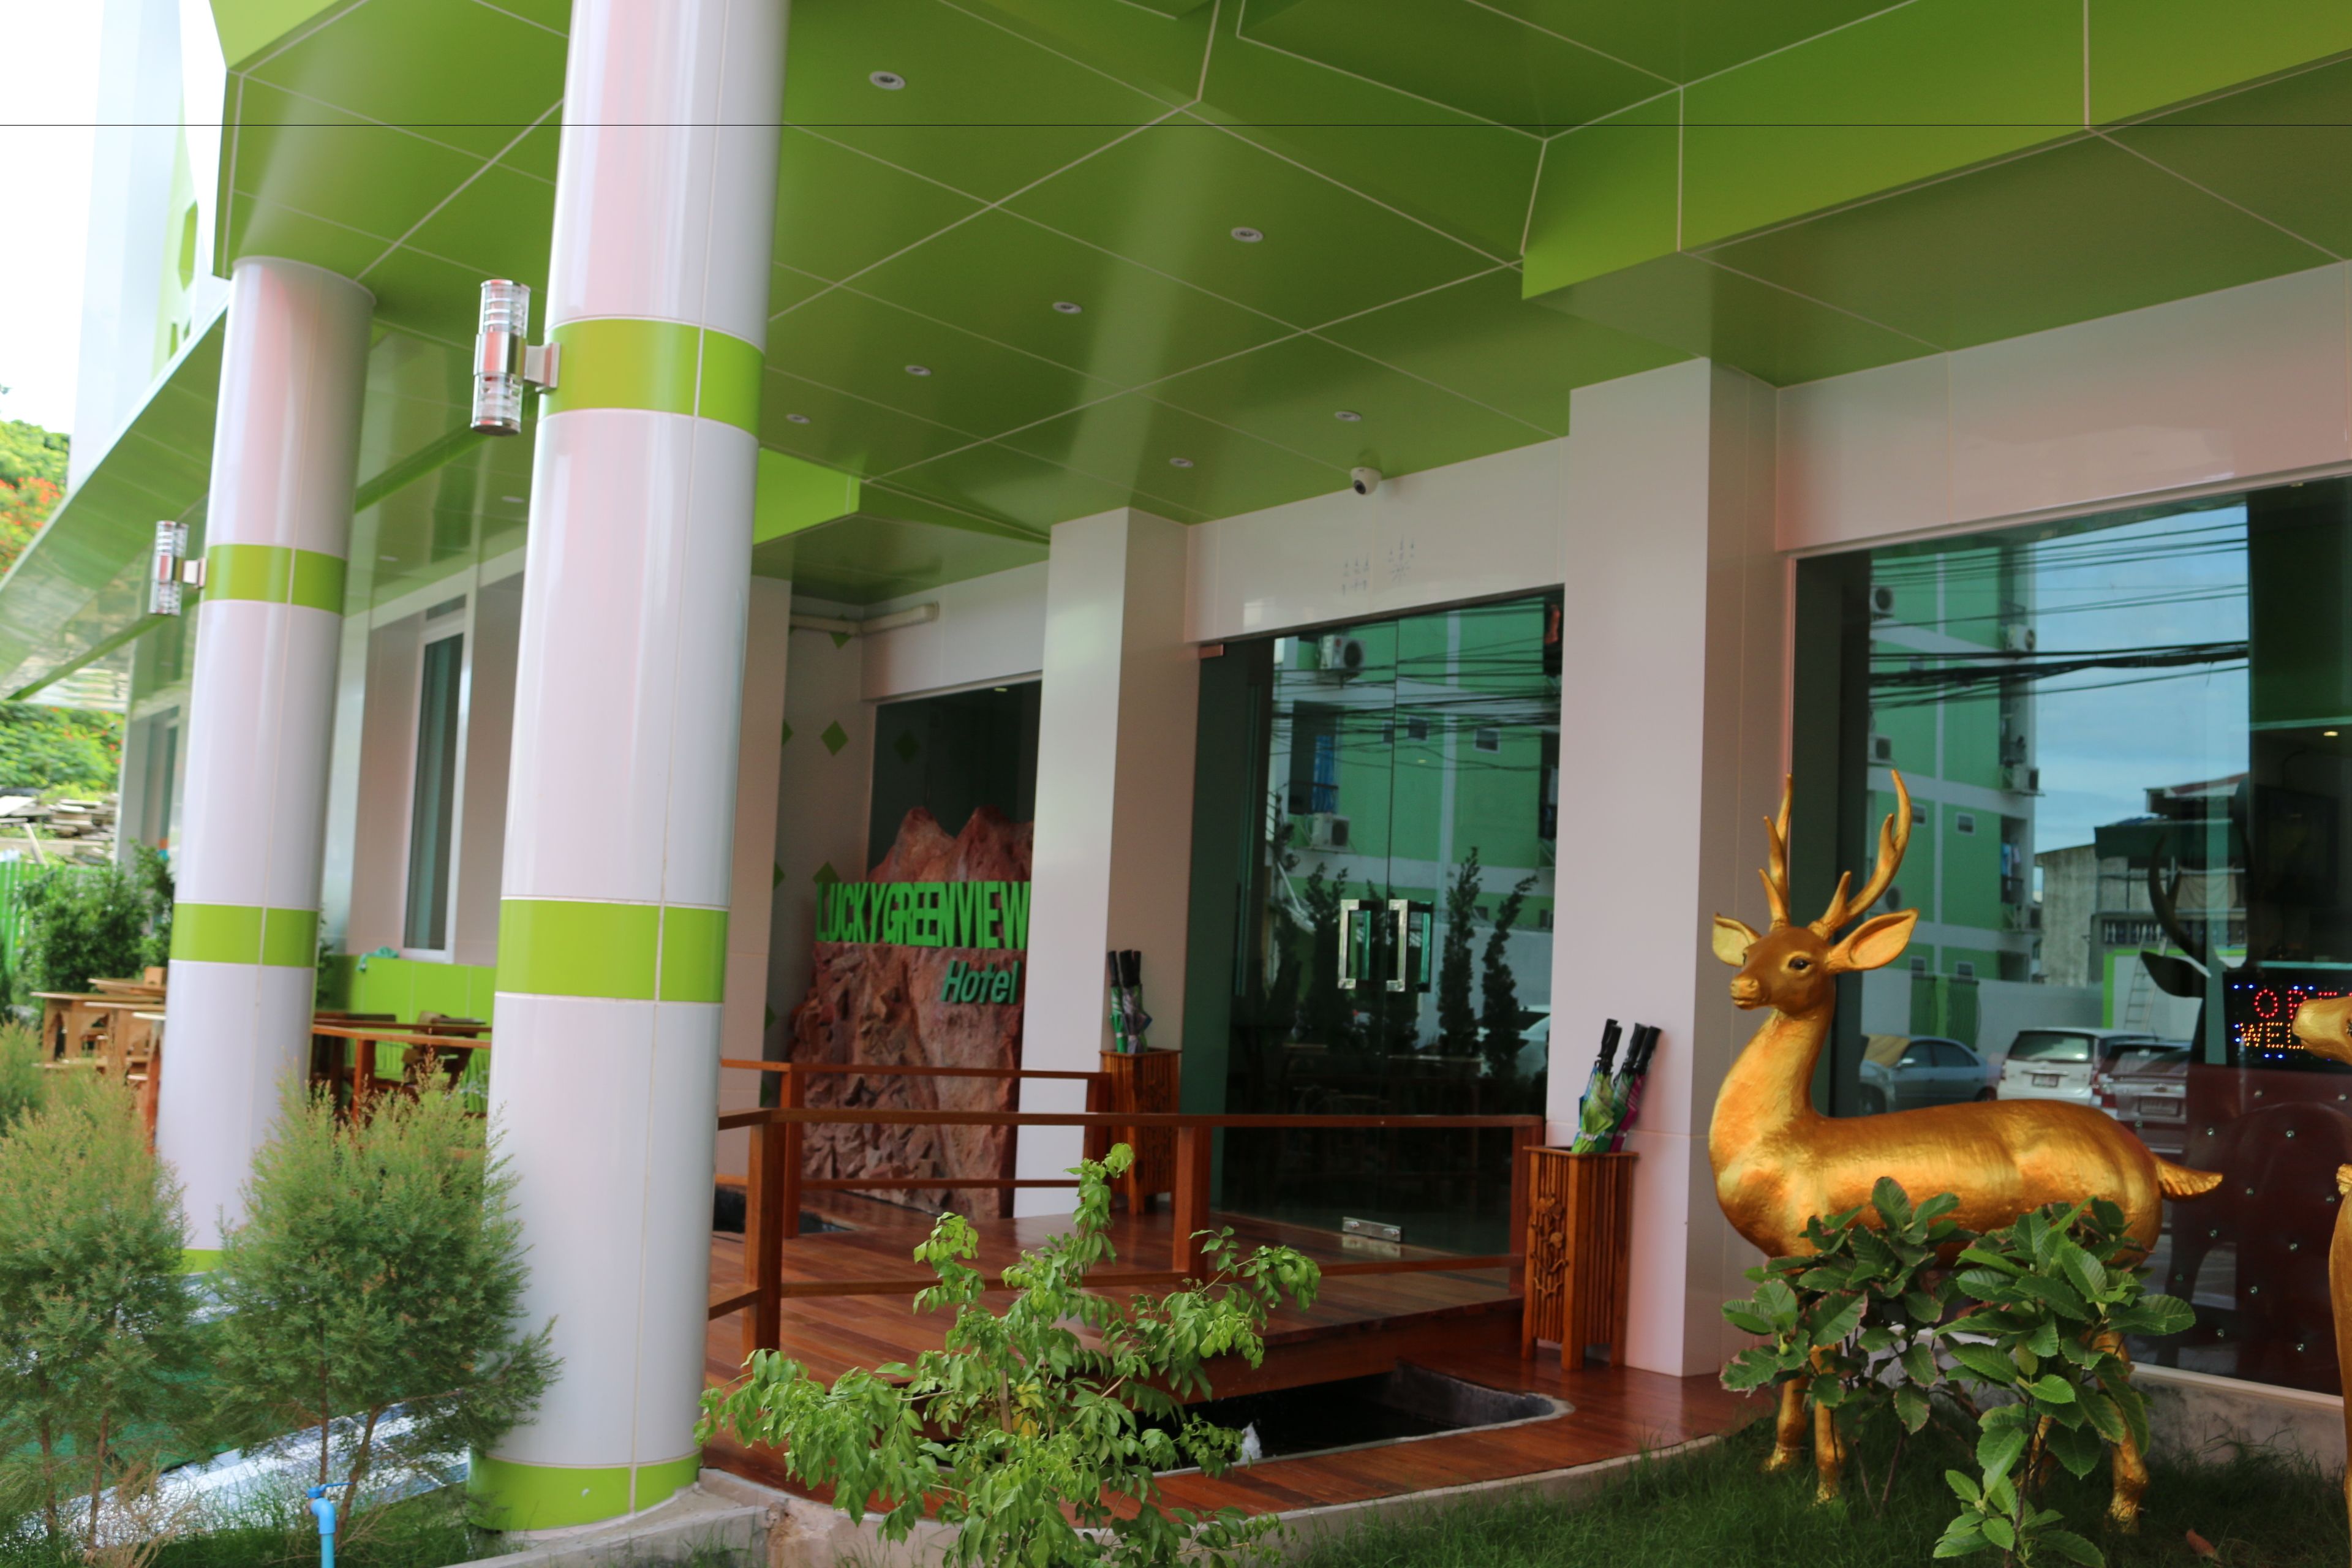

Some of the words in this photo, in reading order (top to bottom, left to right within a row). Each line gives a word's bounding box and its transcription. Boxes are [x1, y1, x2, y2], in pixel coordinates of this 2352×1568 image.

[940, 959, 1021, 1005] Hotel
[2253, 987, 2346, 1020] OP
[2239, 1021, 2305, 1050] WEL
